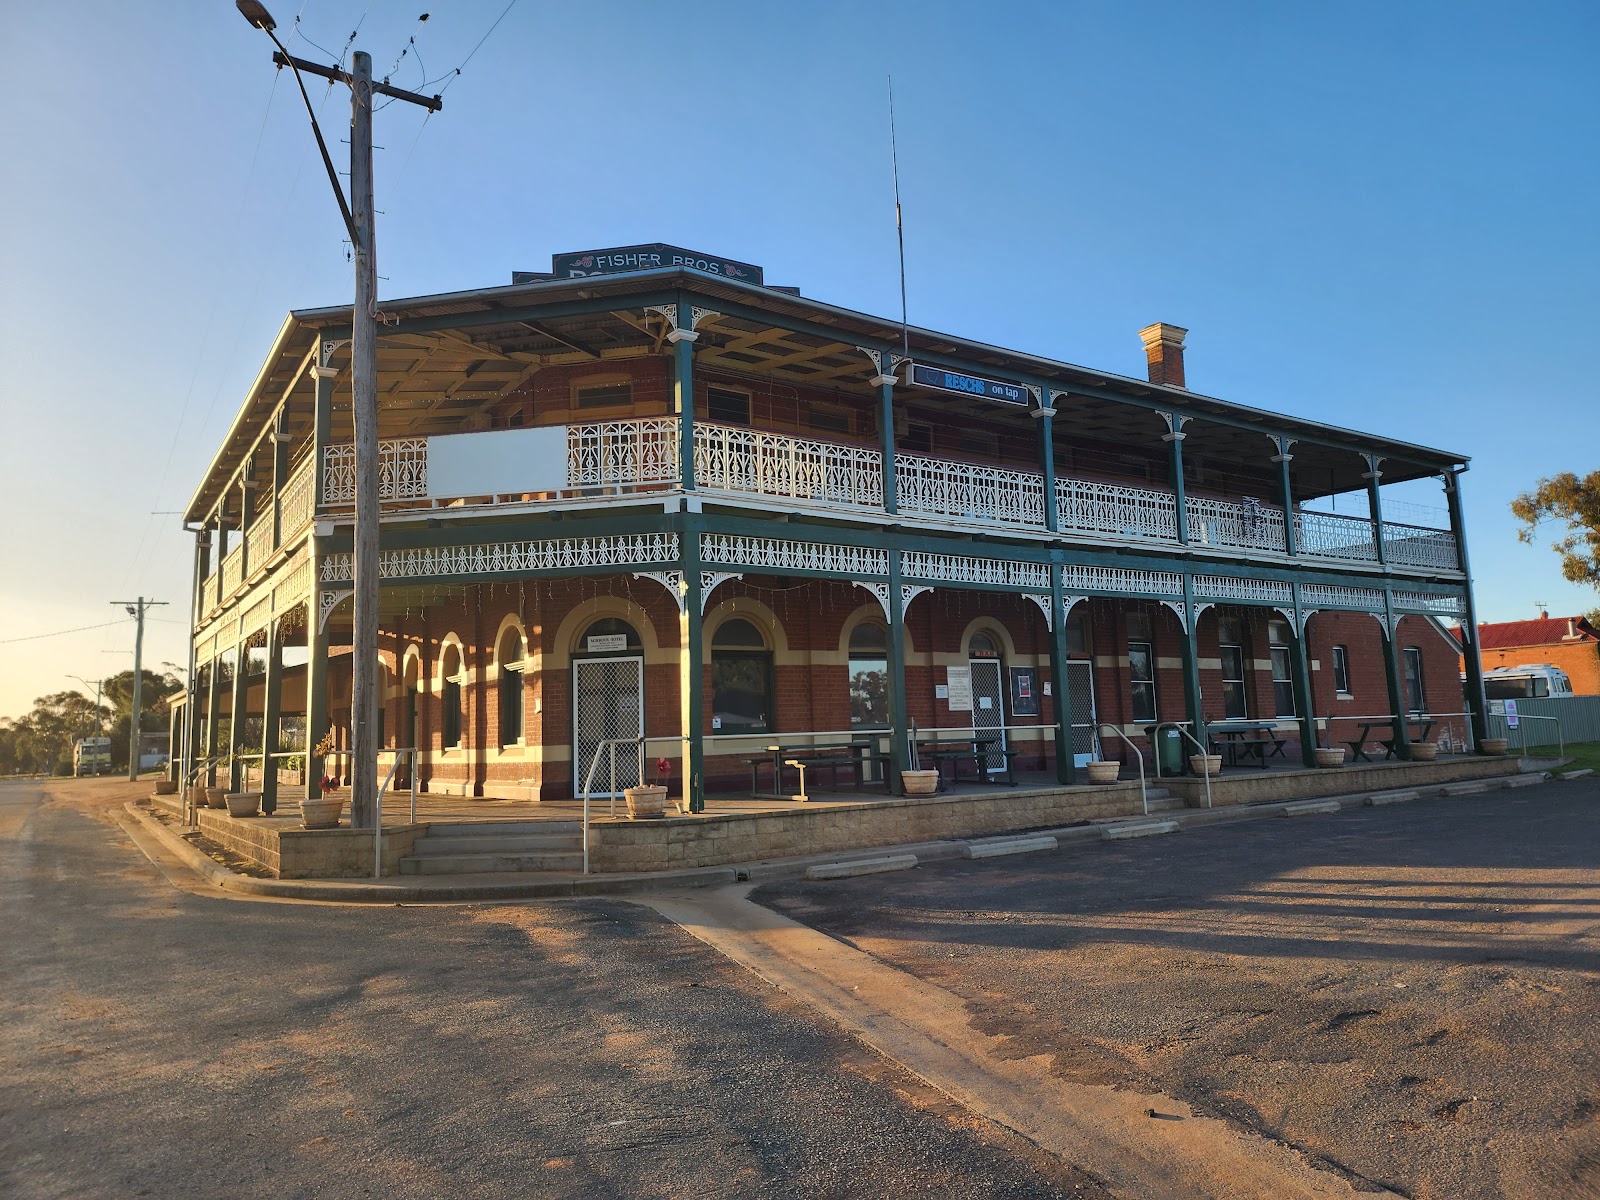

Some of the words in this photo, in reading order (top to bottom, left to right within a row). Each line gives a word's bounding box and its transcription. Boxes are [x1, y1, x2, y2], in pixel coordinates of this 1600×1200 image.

[596, 253, 661, 268] FISHER
[944, 373, 985, 394] RESCHS
[992, 385, 1003, 394] on
[1005, 386, 1019, 400] tap
